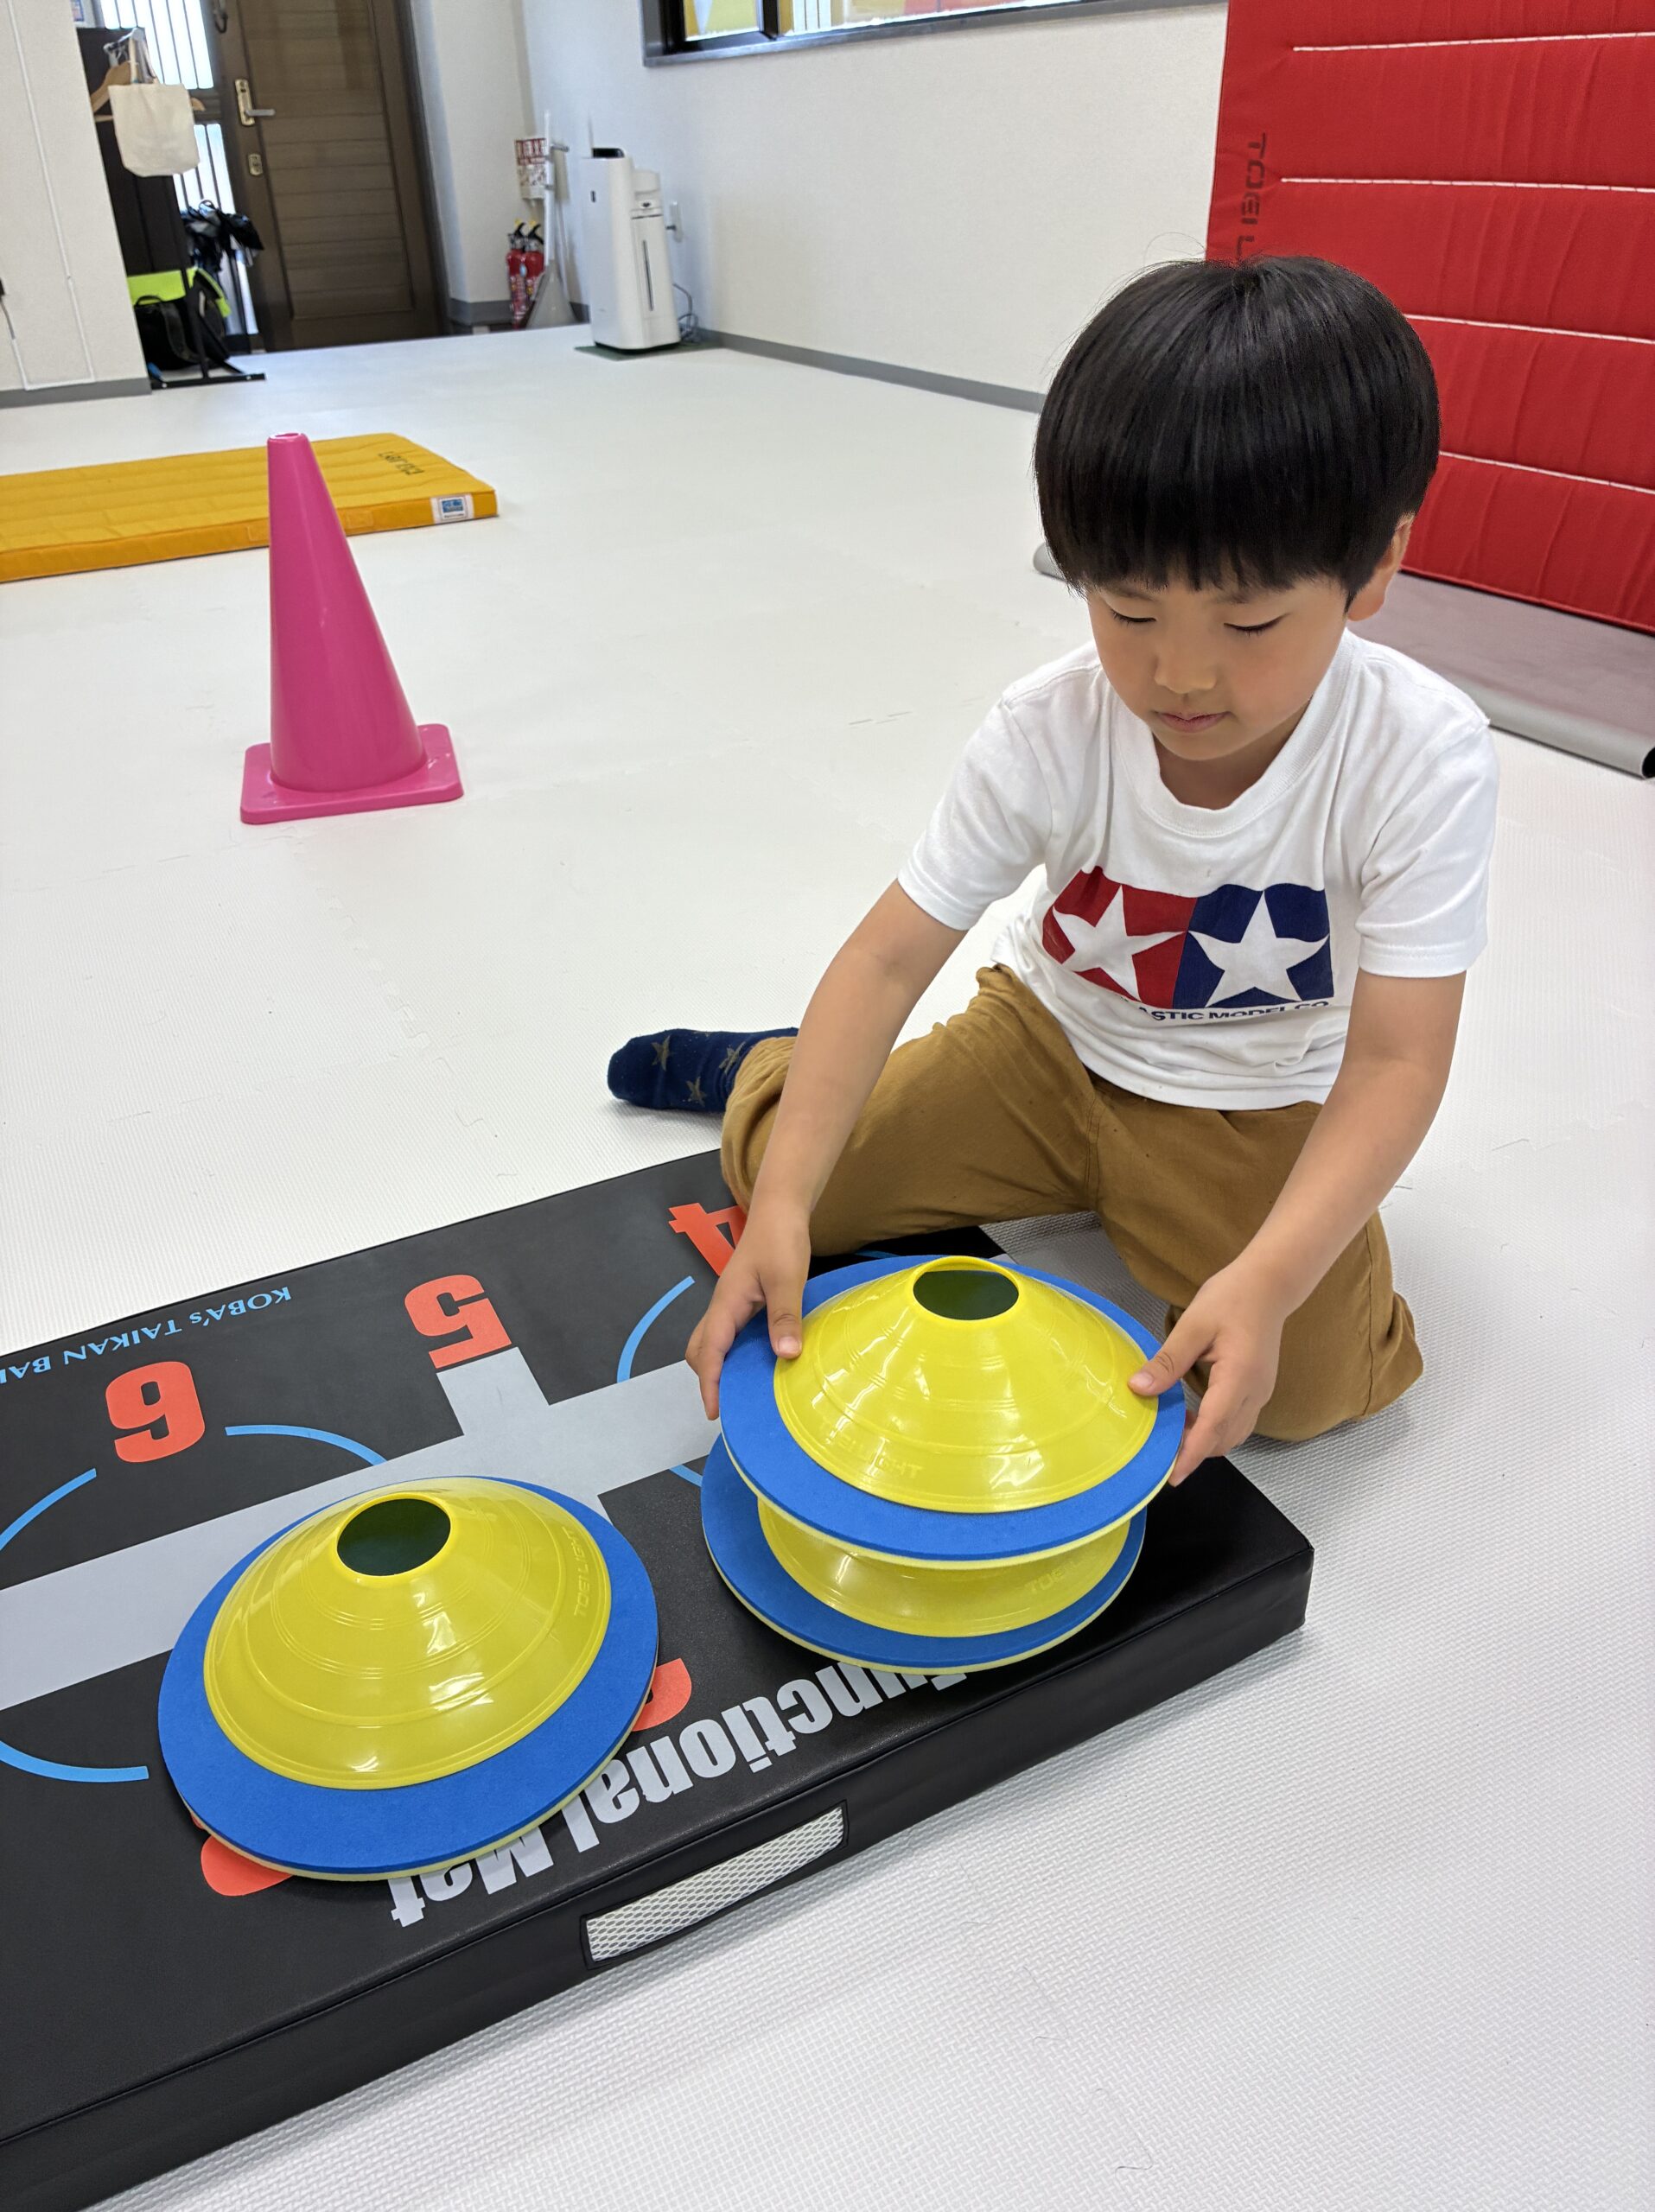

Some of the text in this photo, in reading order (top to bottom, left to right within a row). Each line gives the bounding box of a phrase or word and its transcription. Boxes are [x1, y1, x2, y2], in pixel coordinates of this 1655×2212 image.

[189, 1287, 291, 1326] KOBA's
[404, 1274, 512, 1369] 5
[63, 1319, 182, 1365] TAIKAN
[562, 1662, 967, 1853] nctional
